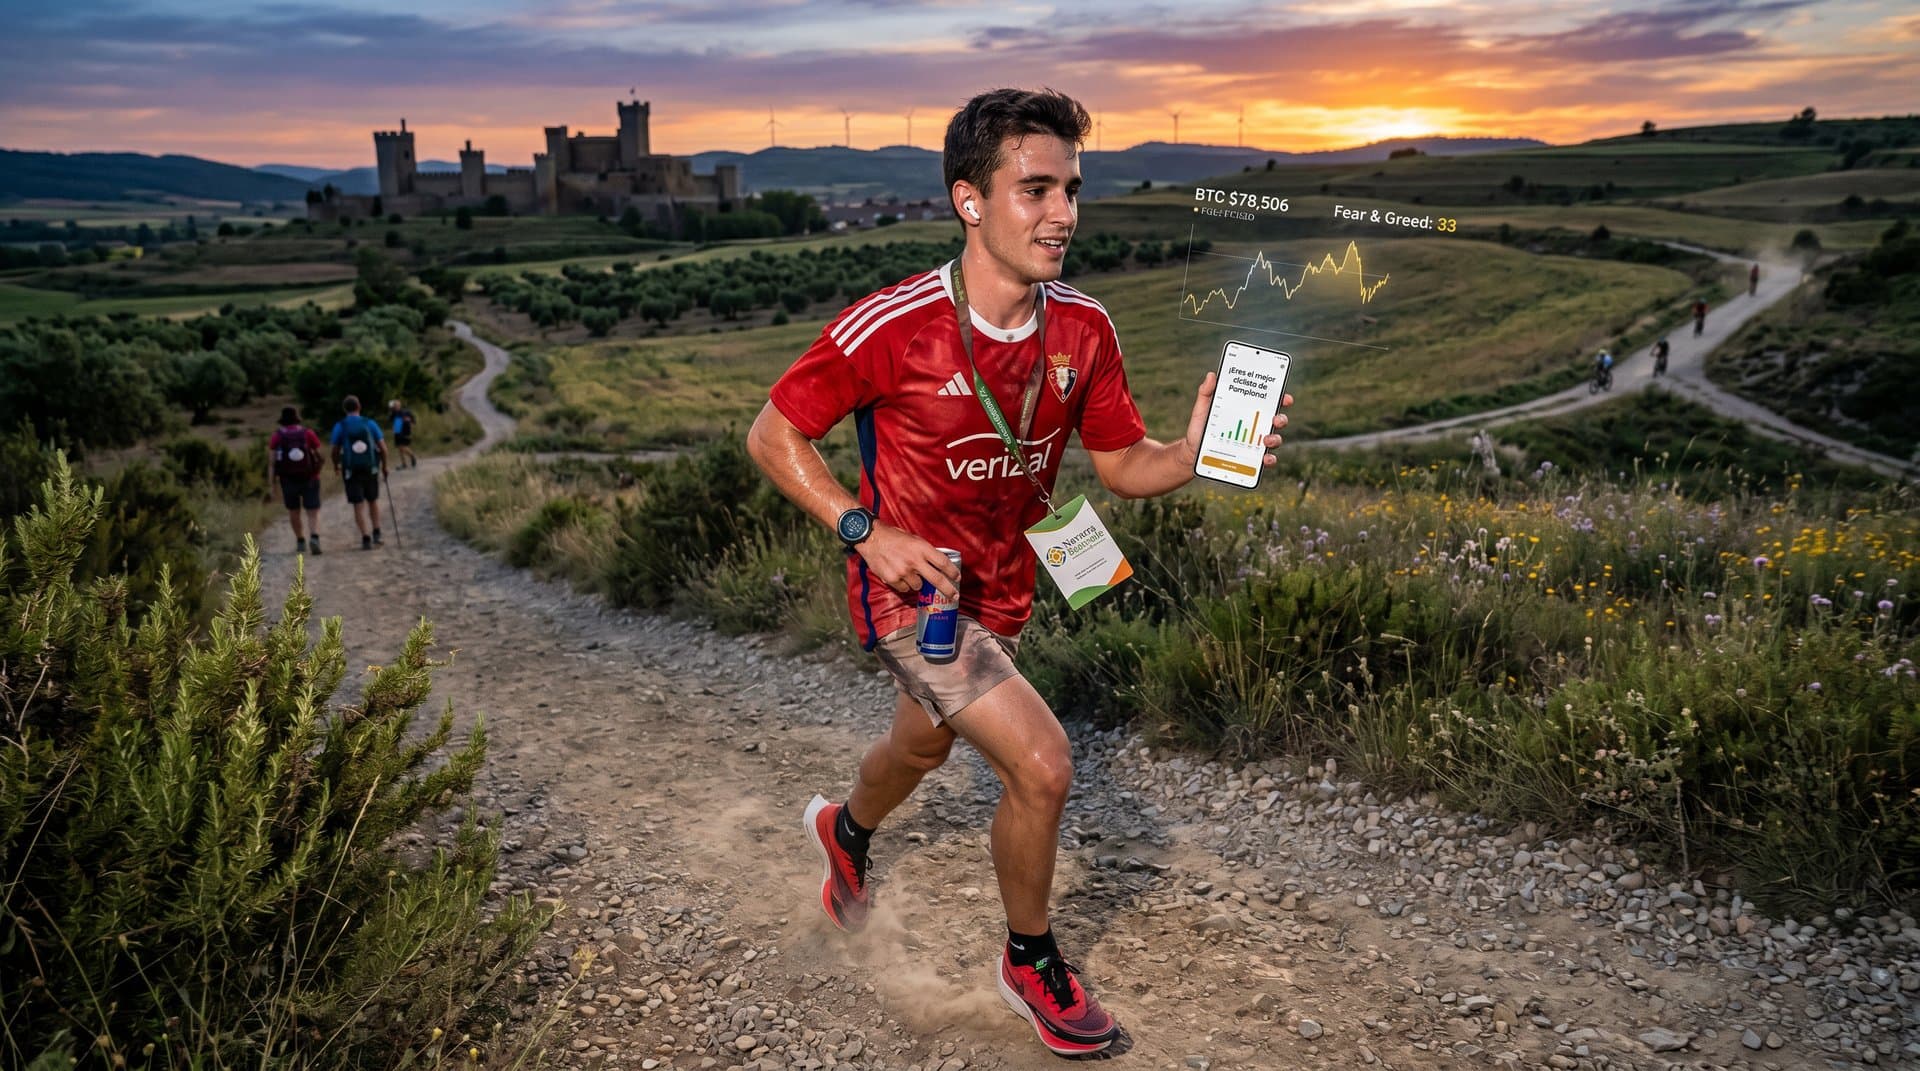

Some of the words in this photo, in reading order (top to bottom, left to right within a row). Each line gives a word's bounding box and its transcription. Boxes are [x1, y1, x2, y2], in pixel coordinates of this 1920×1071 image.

[1228, 366, 1246, 377] ¡Eres
[1247, 369, 1255, 378] el
[1255, 371, 1276, 383] mejor
[1228, 384, 1268, 400] Pamplona!
[1258, 382, 1268, 391] de
[1062, 525, 1097, 548] Navarra
[918, 593, 932, 603] ed
